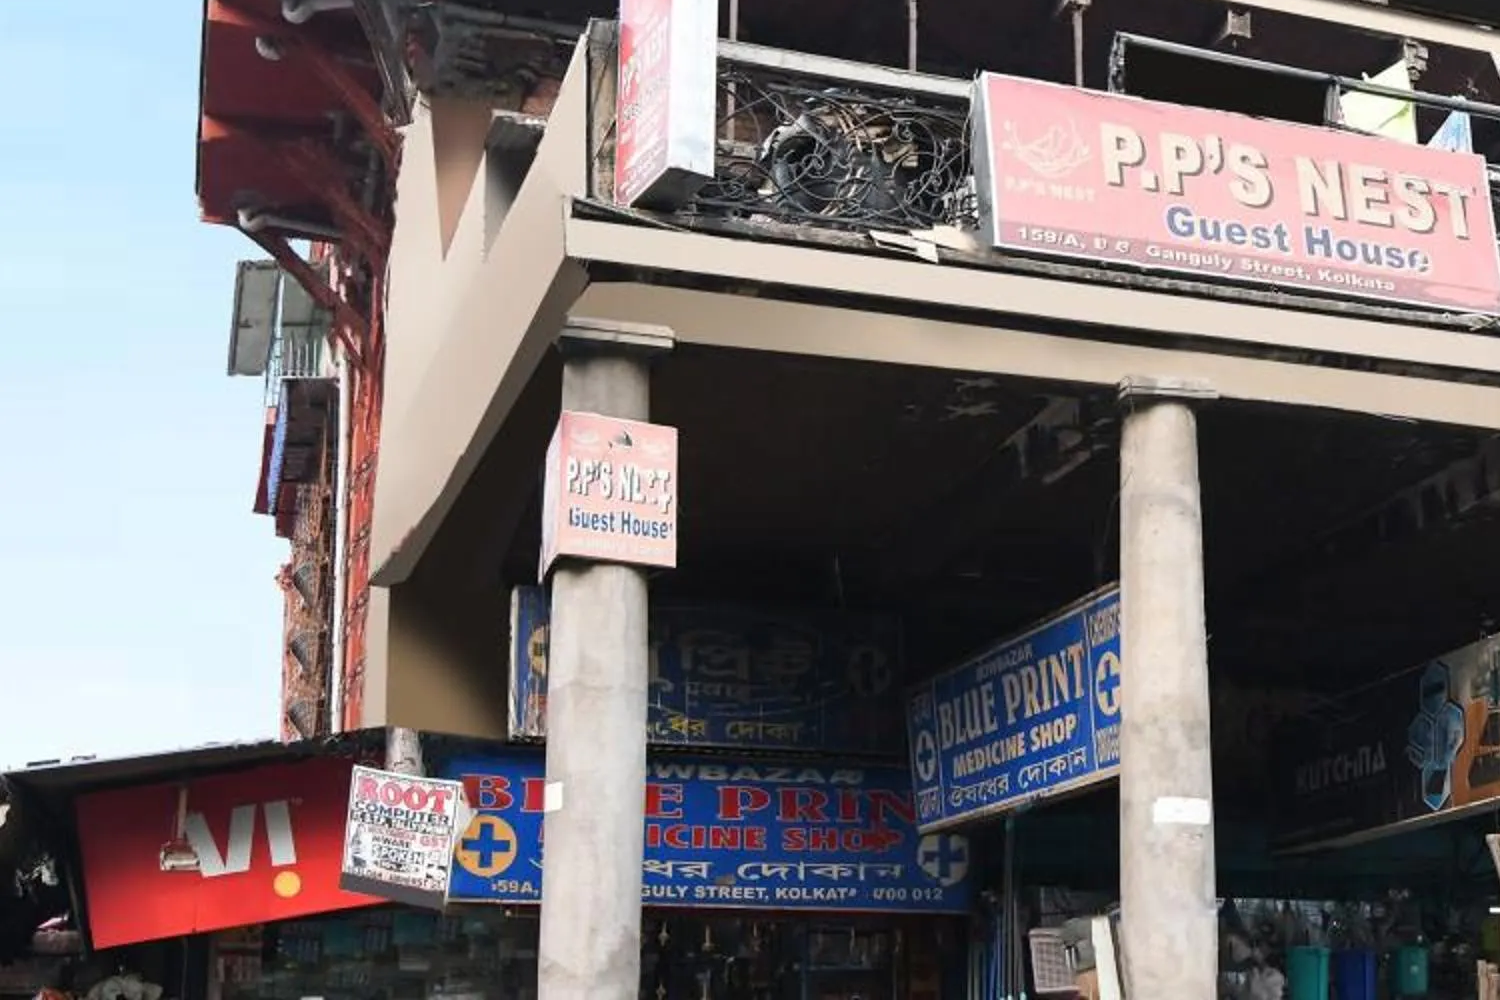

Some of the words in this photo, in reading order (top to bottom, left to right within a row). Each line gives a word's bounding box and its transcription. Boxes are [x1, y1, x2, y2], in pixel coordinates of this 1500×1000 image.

[1099, 121, 1274, 208] P.P'S
[1295, 155, 1476, 240] NEST
[1165, 203, 1291, 253] Guest
[1304, 225, 1430, 274] House
[1146, 244, 1234, 271] Ganguly
[1317, 268, 1396, 292] Kolkata
[569, 506, 615, 533] Guest
[621, 510, 669, 539] House
[939, 682, 998, 751] BLUE
[1002, 642, 1086, 724] PRINT
[953, 730, 1026, 779] MEDICINE
[1031, 712, 1077, 753] SHOP
[355, 800, 449, 825] COMPUTER
[358, 775, 453, 815] ROOT
[694, 885, 770, 900] STREET,
[911, 887, 943, 900] 012
